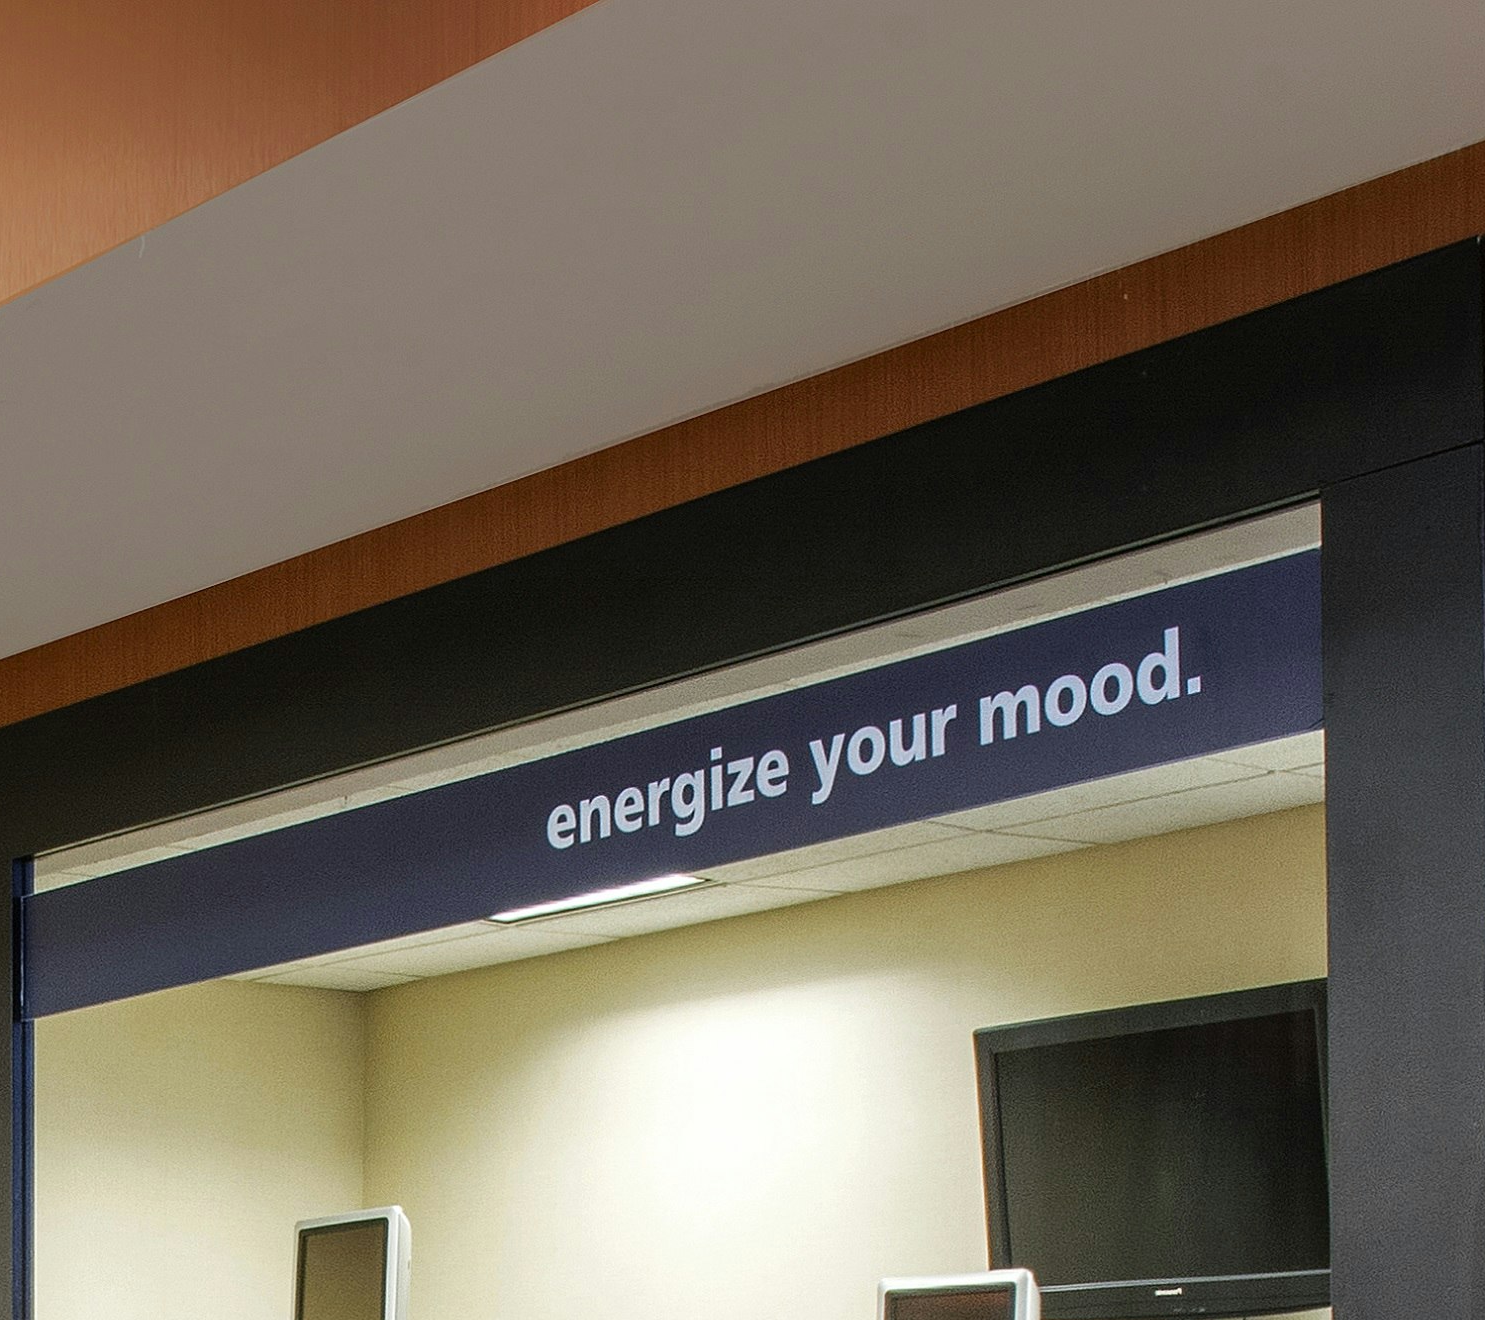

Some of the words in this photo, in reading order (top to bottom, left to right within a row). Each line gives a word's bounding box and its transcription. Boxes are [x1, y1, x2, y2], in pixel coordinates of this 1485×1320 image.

[547, 747, 789, 849] energize
[809, 704, 957, 805] your
[980, 626, 1201, 745] mood.
